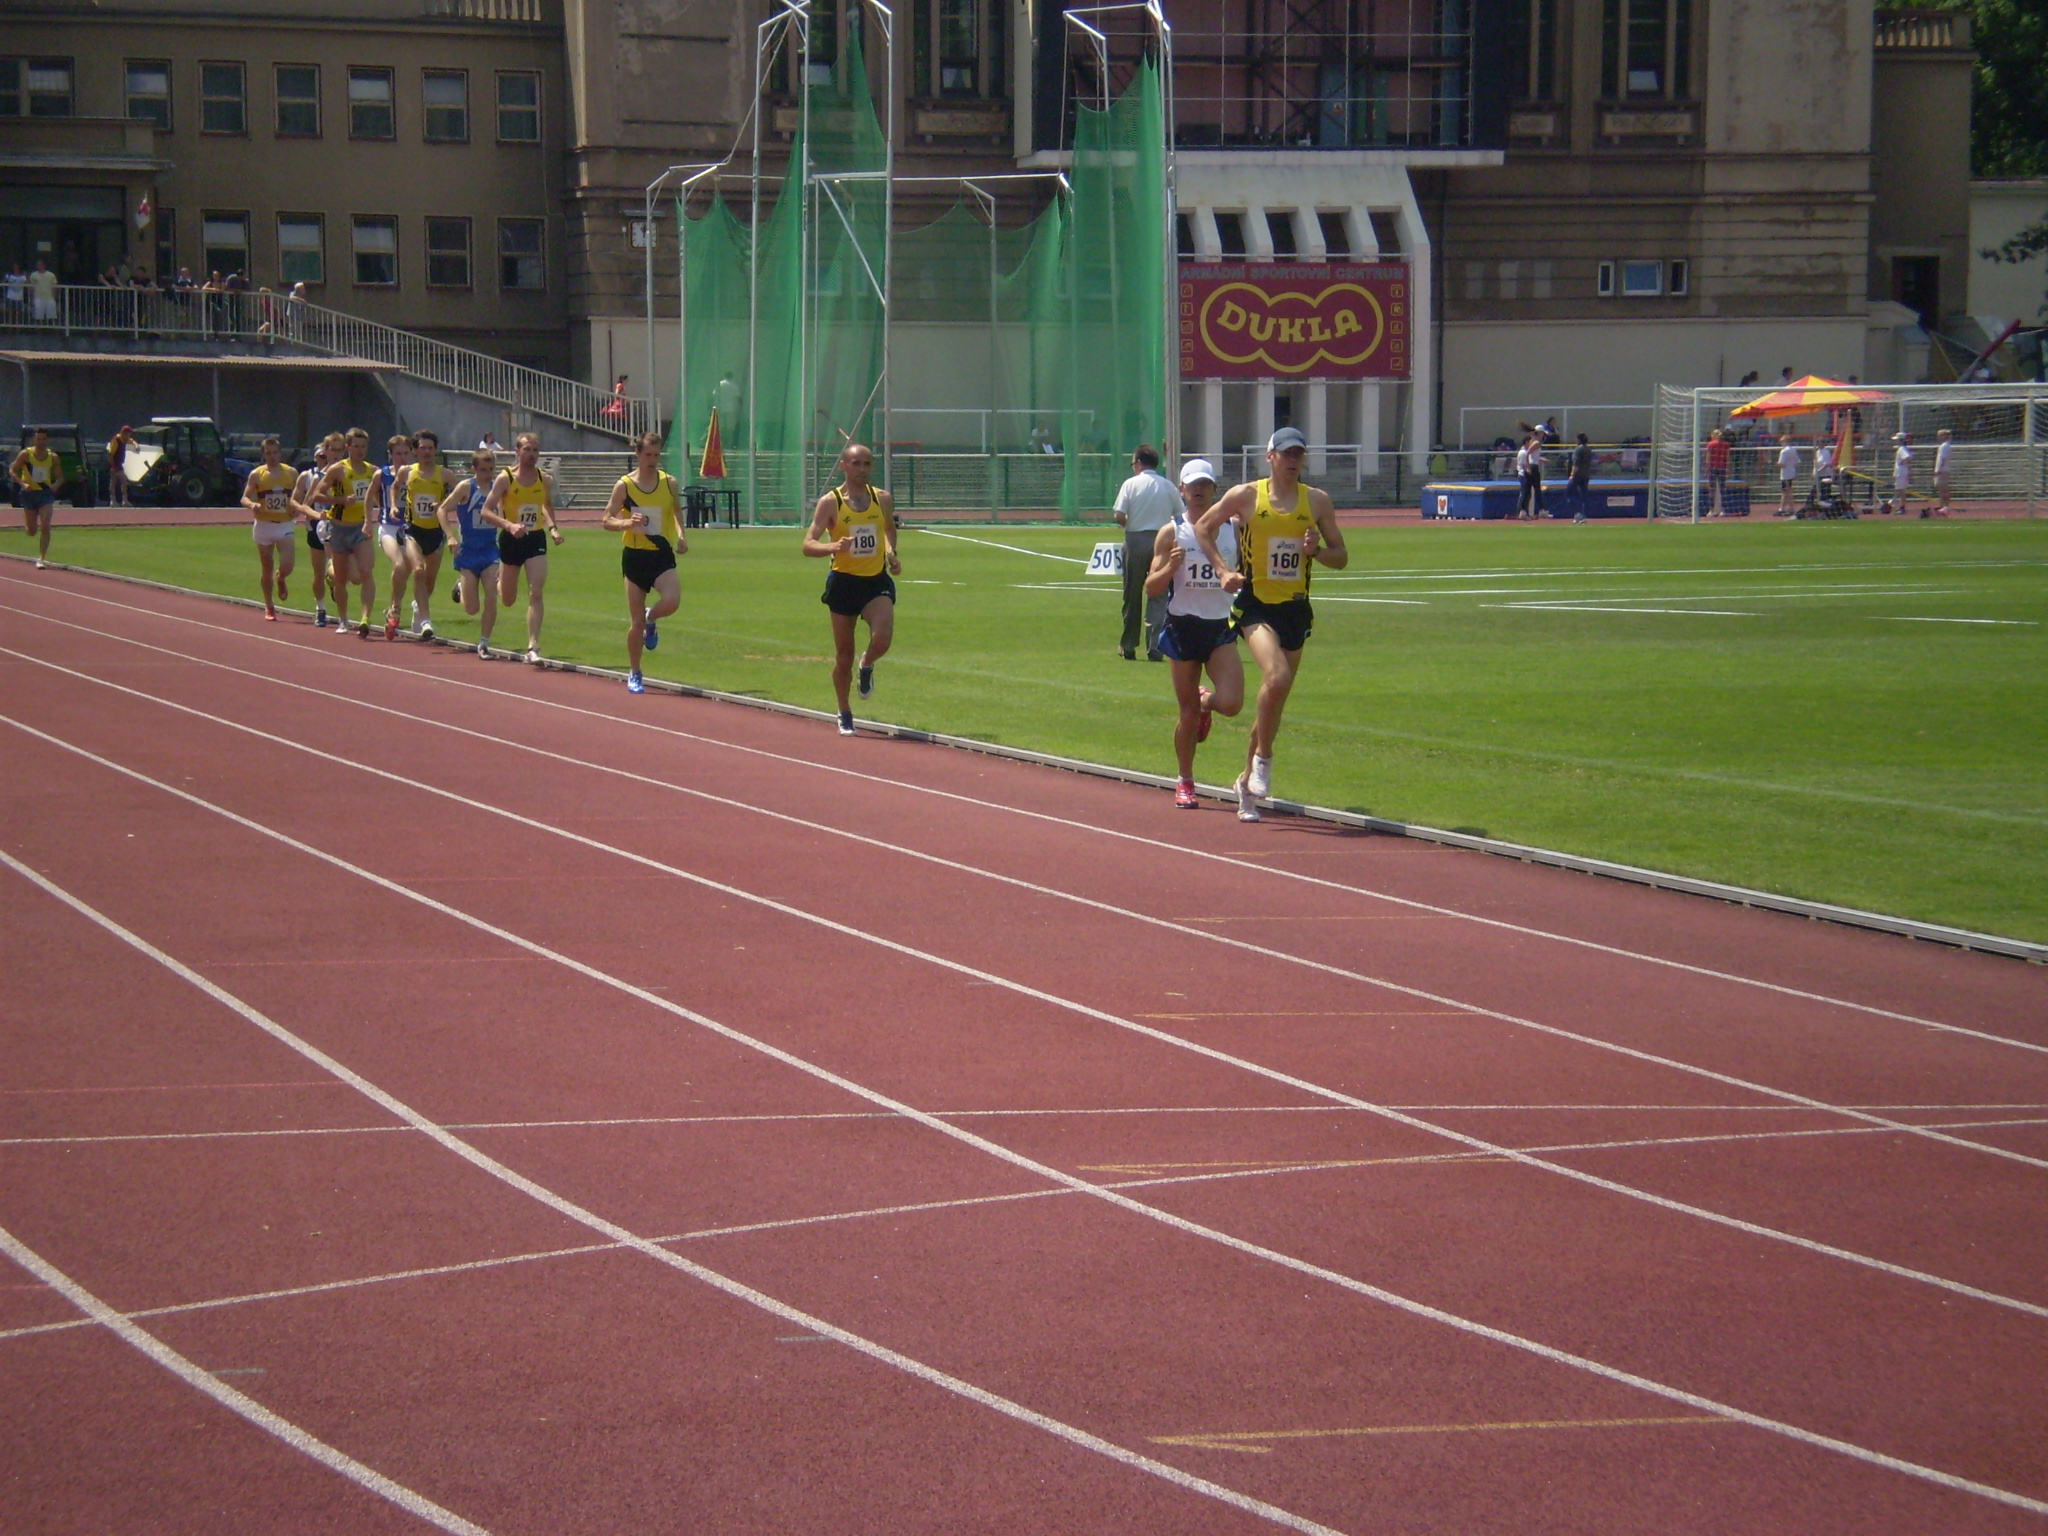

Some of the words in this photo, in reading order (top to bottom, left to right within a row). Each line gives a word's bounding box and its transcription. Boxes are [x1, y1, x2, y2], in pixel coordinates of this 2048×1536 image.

[1250, 264, 1330, 280] SPORTOVNÍ
[1336, 267, 1404, 280] CENTRUM
[1217, 300, 1363, 343] DUKLA
[266, 497, 287, 510] 324
[520, 513, 537, 523] 176
[854, 535, 875, 549] 180
[1271, 553, 1299, 569] 160
